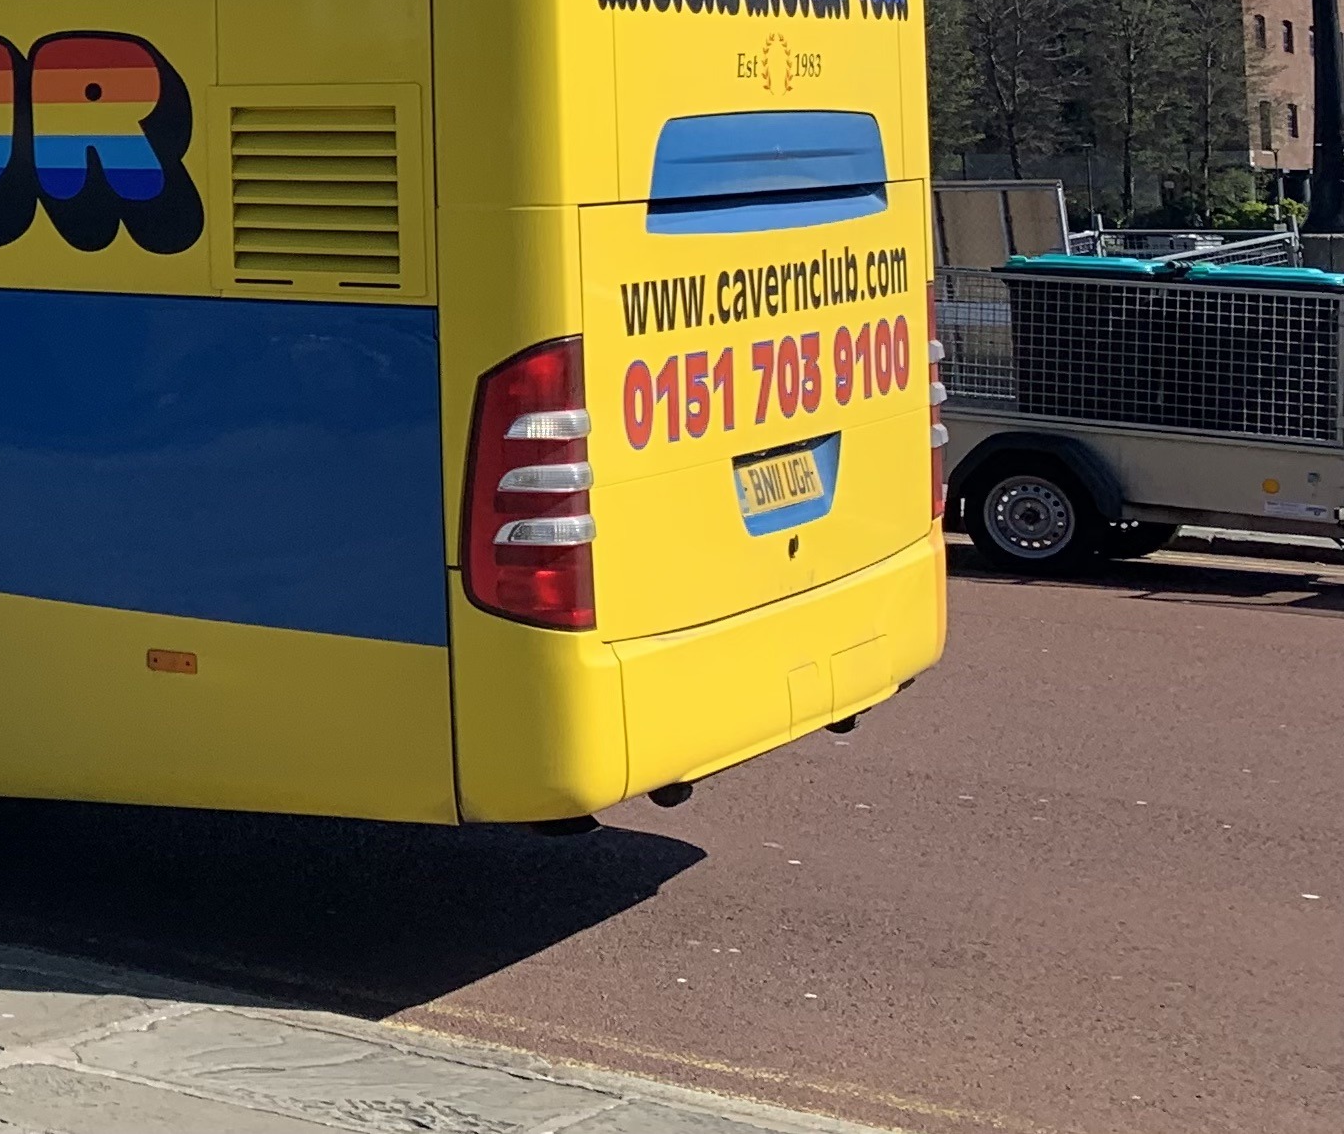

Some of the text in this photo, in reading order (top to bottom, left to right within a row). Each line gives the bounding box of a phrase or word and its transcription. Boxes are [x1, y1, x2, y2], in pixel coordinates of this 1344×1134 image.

[737, 53, 758, 79] Est
[620, 246, 909, 337] www.cavernclub.com
[623, 315, 910, 450] 0151 703 9100
[782, 456, 816, 497] UGH
